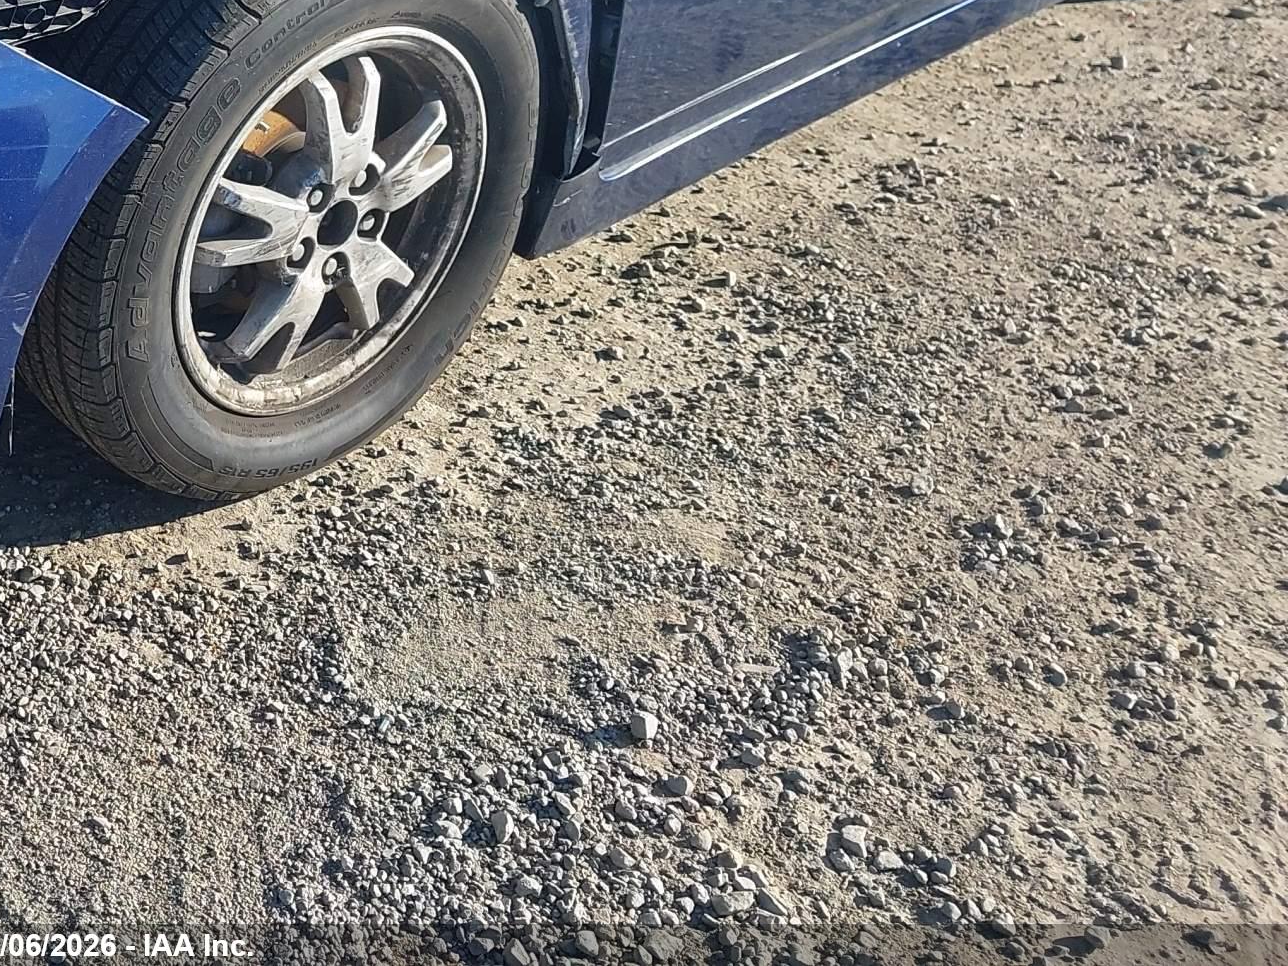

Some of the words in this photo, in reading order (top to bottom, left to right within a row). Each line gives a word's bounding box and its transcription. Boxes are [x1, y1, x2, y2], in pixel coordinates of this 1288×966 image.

[126, 77, 241, 363] Advantage
[218, 465, 252, 478] R15
[253, 457, 318, 478] 195/65
